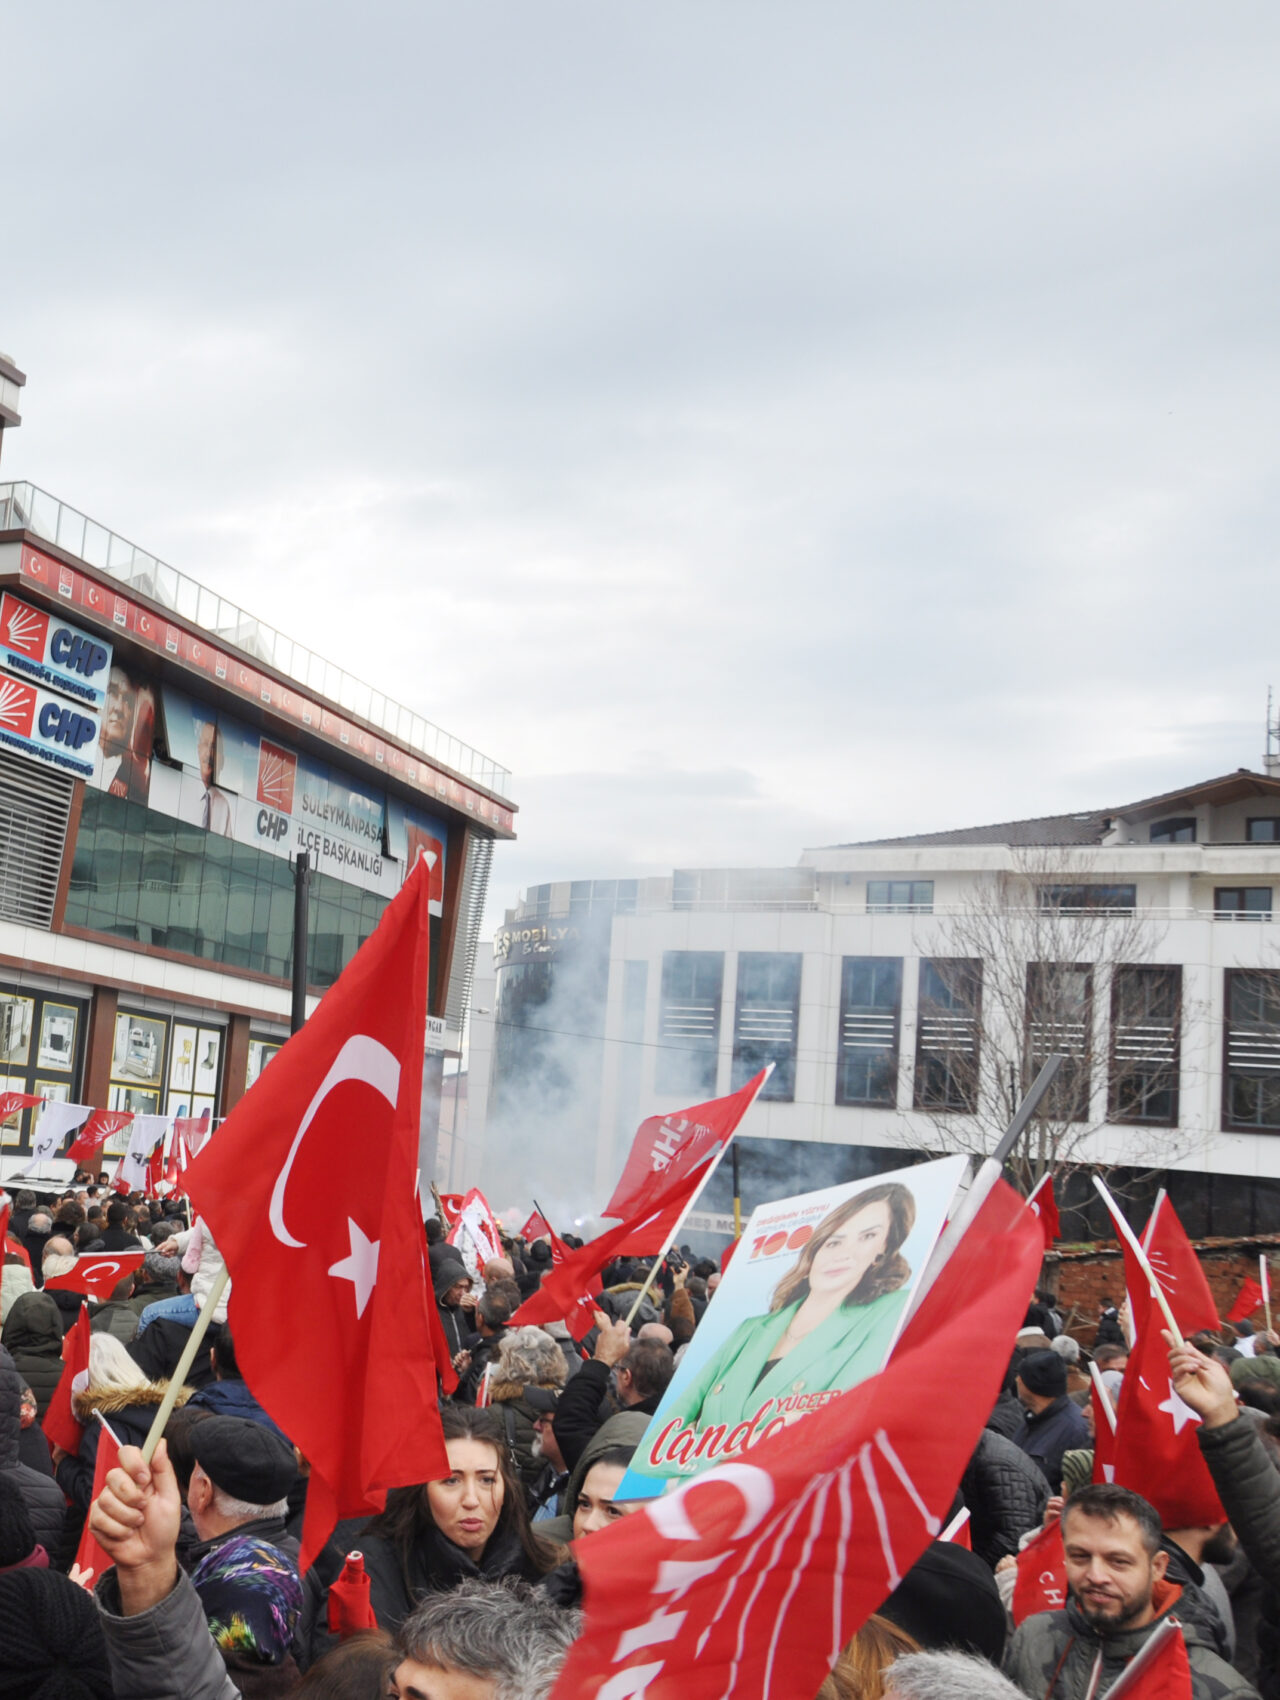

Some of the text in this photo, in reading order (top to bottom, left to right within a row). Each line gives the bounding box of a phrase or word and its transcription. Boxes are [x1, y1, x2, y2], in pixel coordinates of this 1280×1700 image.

[50, 627, 108, 678] CHP
[38, 702, 97, 750] CHP
[256, 809, 289, 842] CHP
[322, 838, 383, 877] BAŞKANLIĞI
[1038, 1571, 1065, 1604] CH
